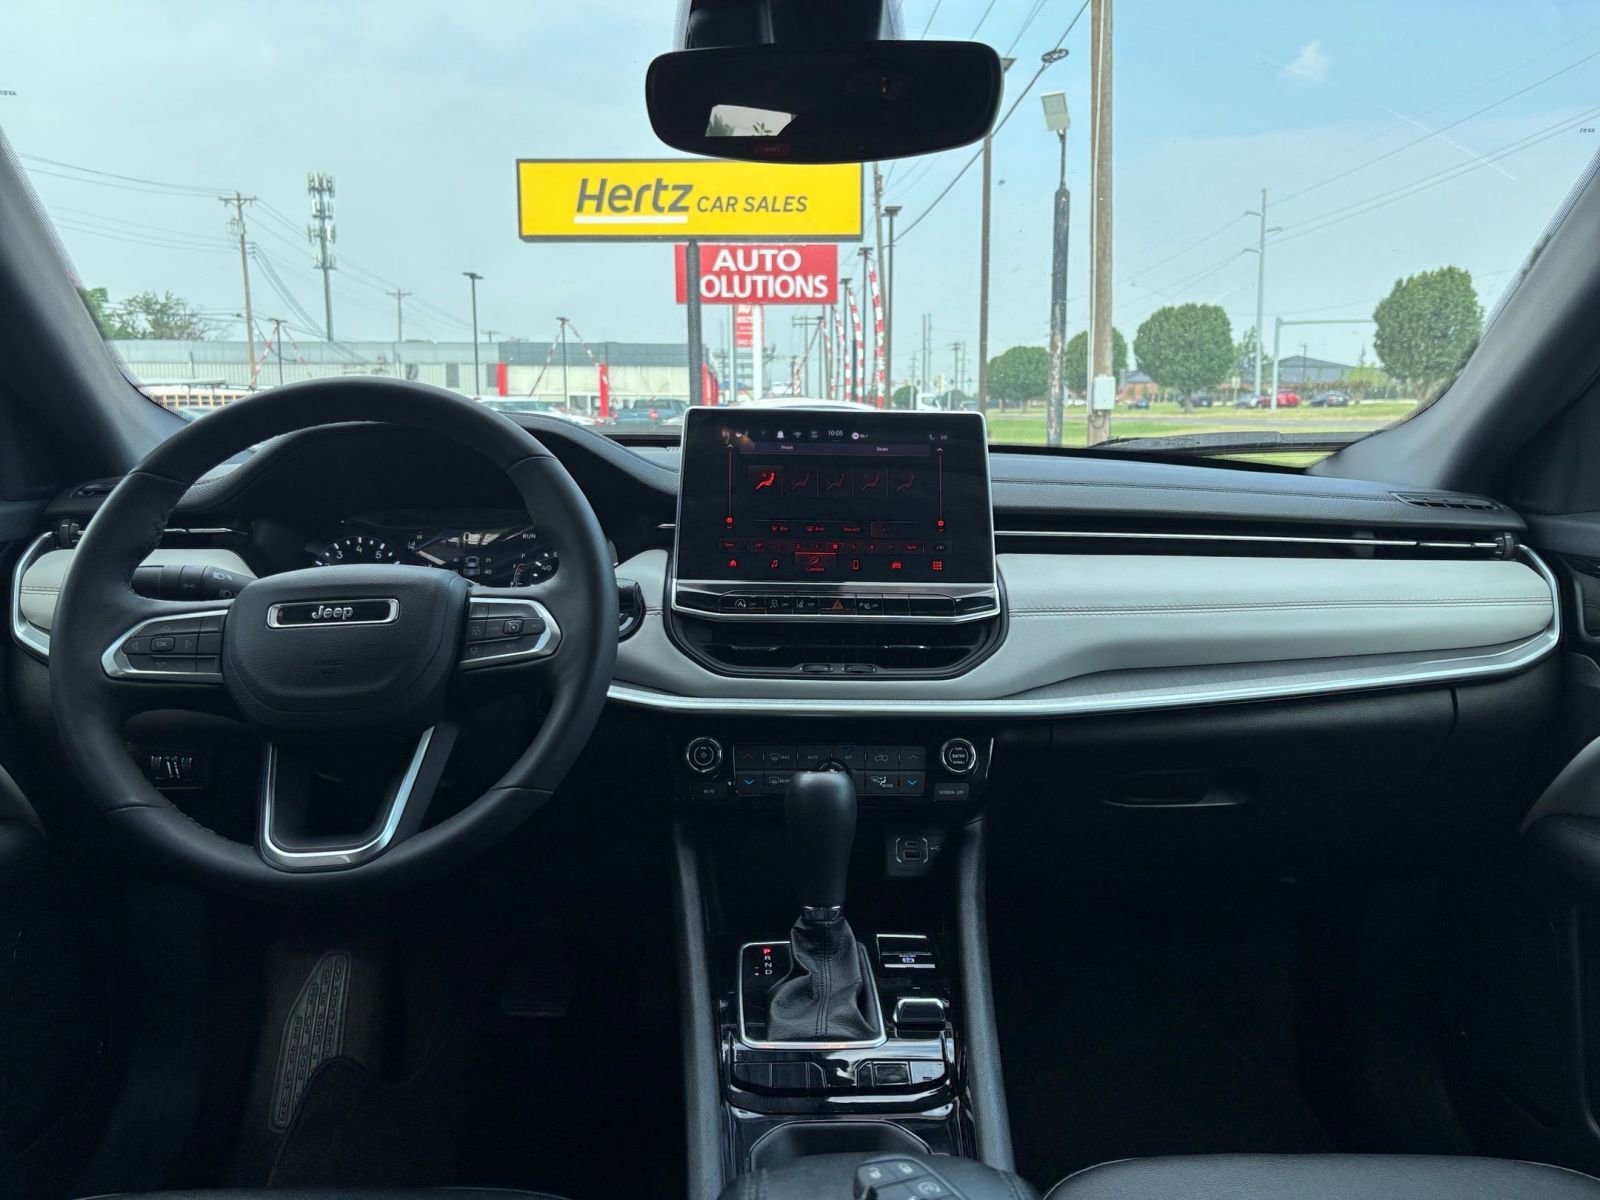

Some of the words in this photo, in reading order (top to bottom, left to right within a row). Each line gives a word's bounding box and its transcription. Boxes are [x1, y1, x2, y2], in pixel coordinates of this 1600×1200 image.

[576, 177, 694, 213] Hertz
[697, 196, 738, 213] CAR
[743, 196, 808, 213] SALES
[712, 249, 801, 272] AUTO
[700, 274, 829, 298] OLUTIONS
[336, 550, 344, 559] 3
[355, 545, 363, 553] 4
[375, 550, 383, 559] 5
[312, 605, 354, 620] Jeep
